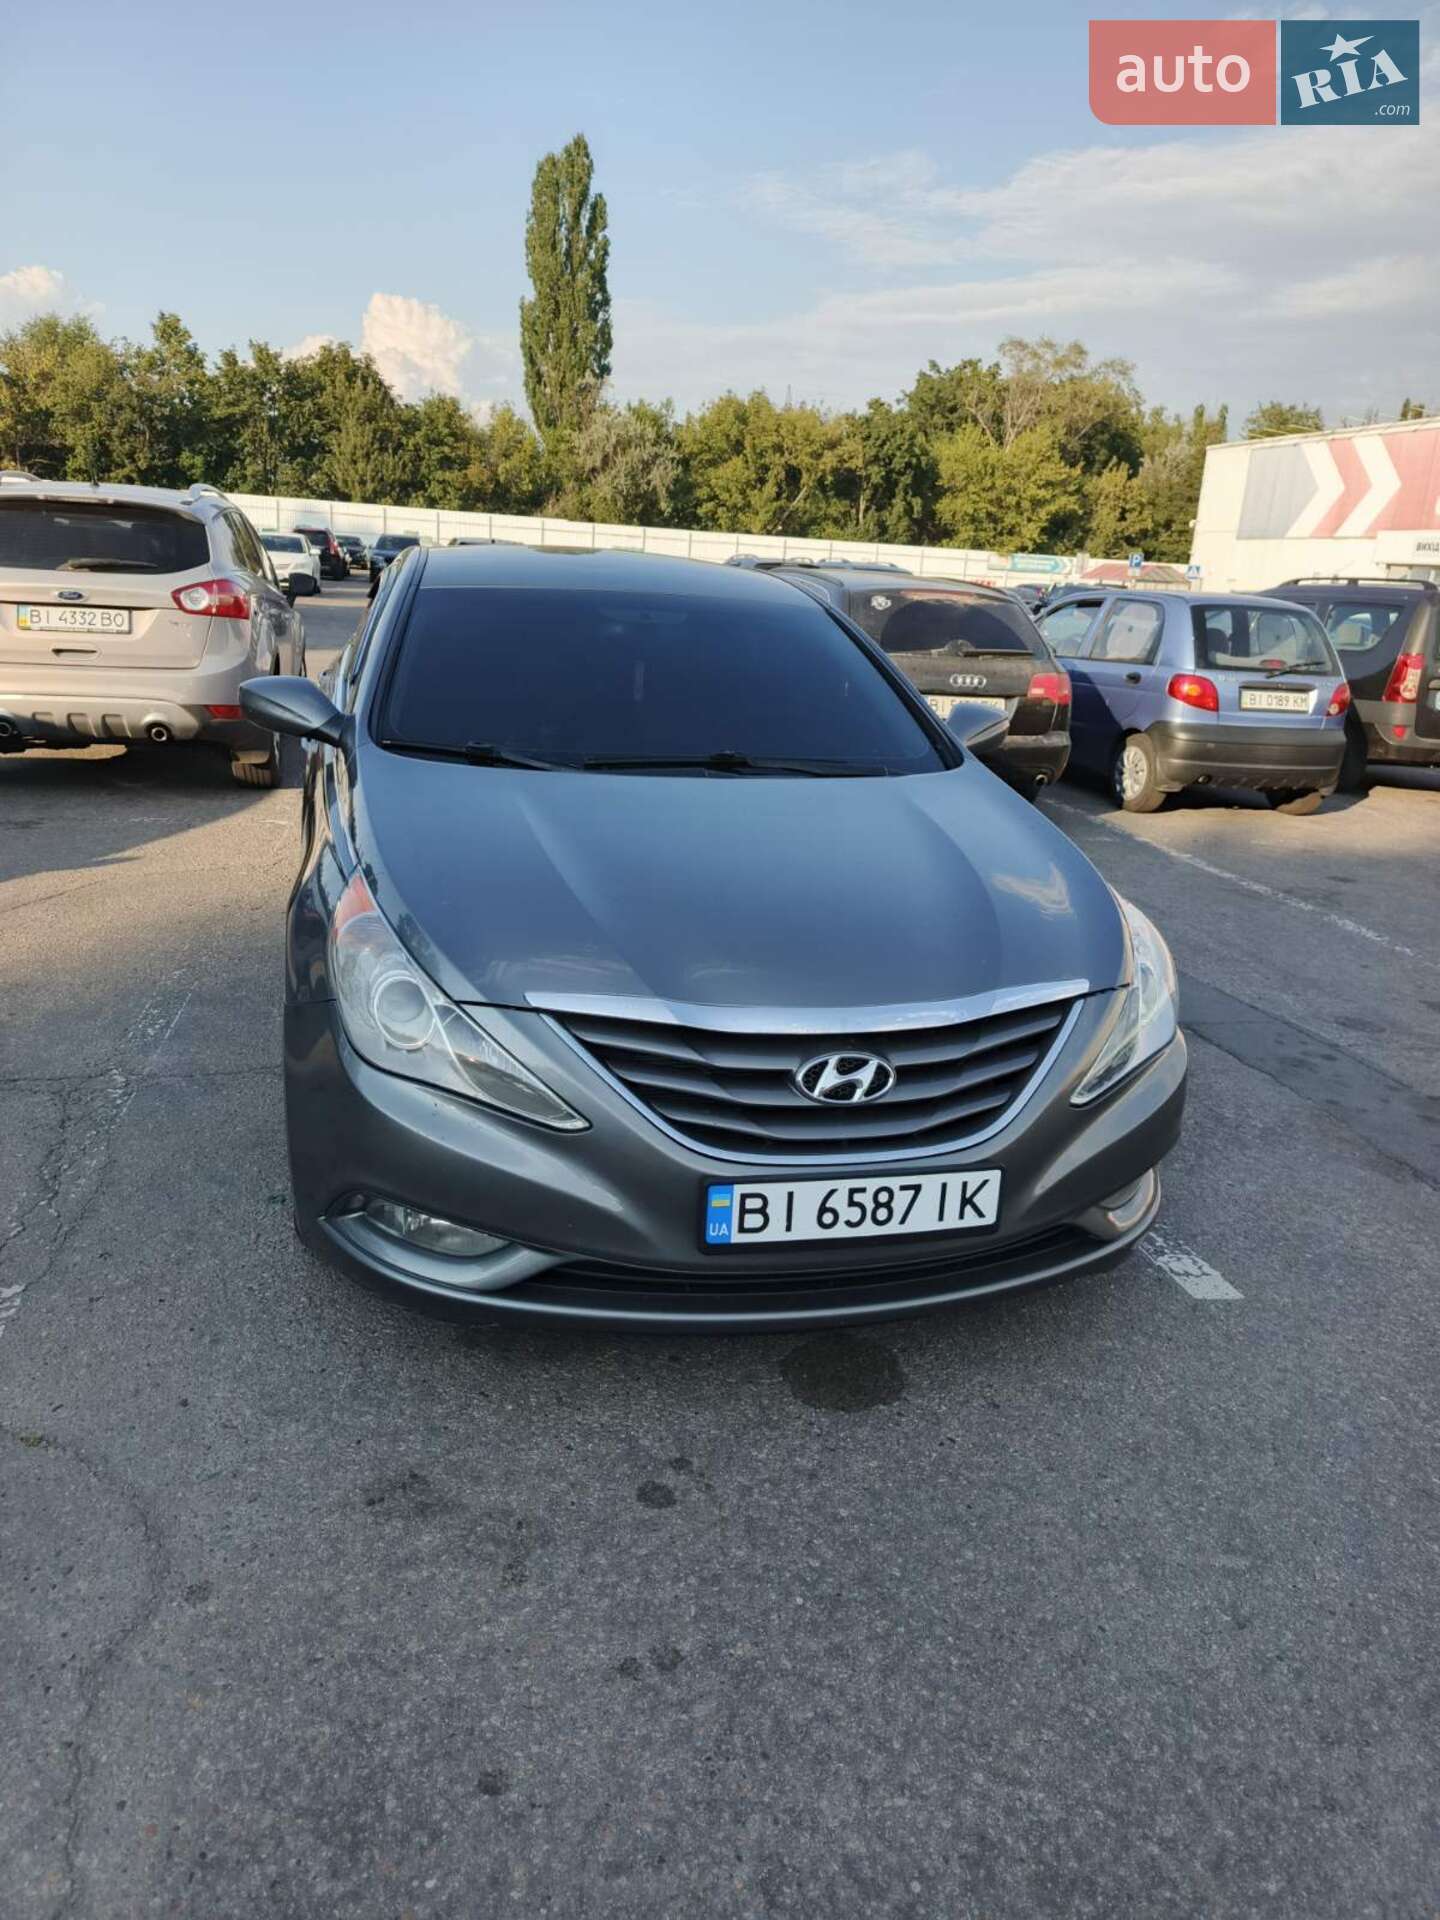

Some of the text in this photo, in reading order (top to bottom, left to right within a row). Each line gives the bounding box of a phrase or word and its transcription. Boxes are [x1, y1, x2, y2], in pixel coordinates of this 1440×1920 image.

[30, 608, 125, 628] BI 4332 BO
[737, 1178, 990, 1234] BI 6587 IK
[709, 1223, 729, 1236] UA
